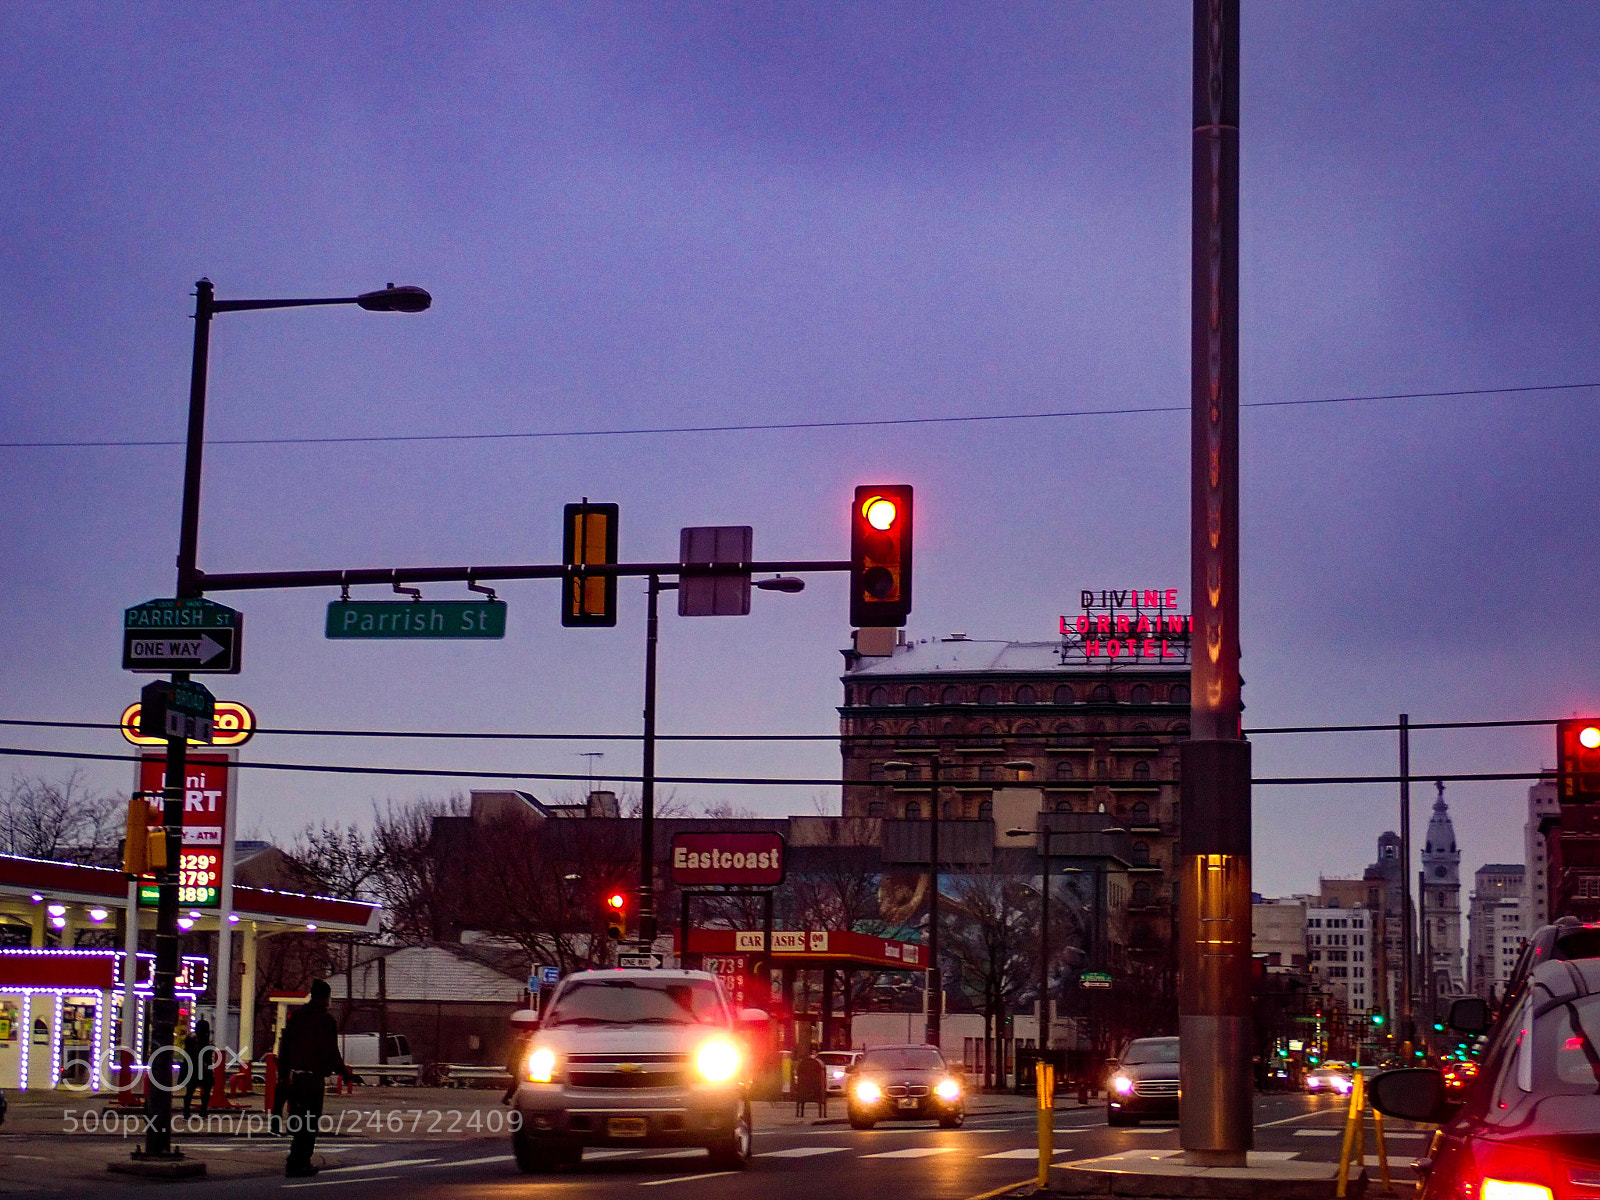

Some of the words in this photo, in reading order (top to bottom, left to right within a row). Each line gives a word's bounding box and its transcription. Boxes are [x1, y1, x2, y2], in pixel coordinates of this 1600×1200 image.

[1081, 589, 1178, 608] DIVINE
[127, 610, 203, 626] PARRISH
[216, 614, 230, 624] ST
[342, 608, 444, 631] Parrish
[460, 609, 488, 630] St
[134, 642, 164, 656] ONE
[169, 642, 201, 656] WAY
[1085, 638, 1175, 657] HOTEL
[197, 832, 219, 840] ATM
[674, 847, 779, 869] Eastcoast
[741, 935, 762, 946] CAR
[772, 935, 795, 946] ASH
